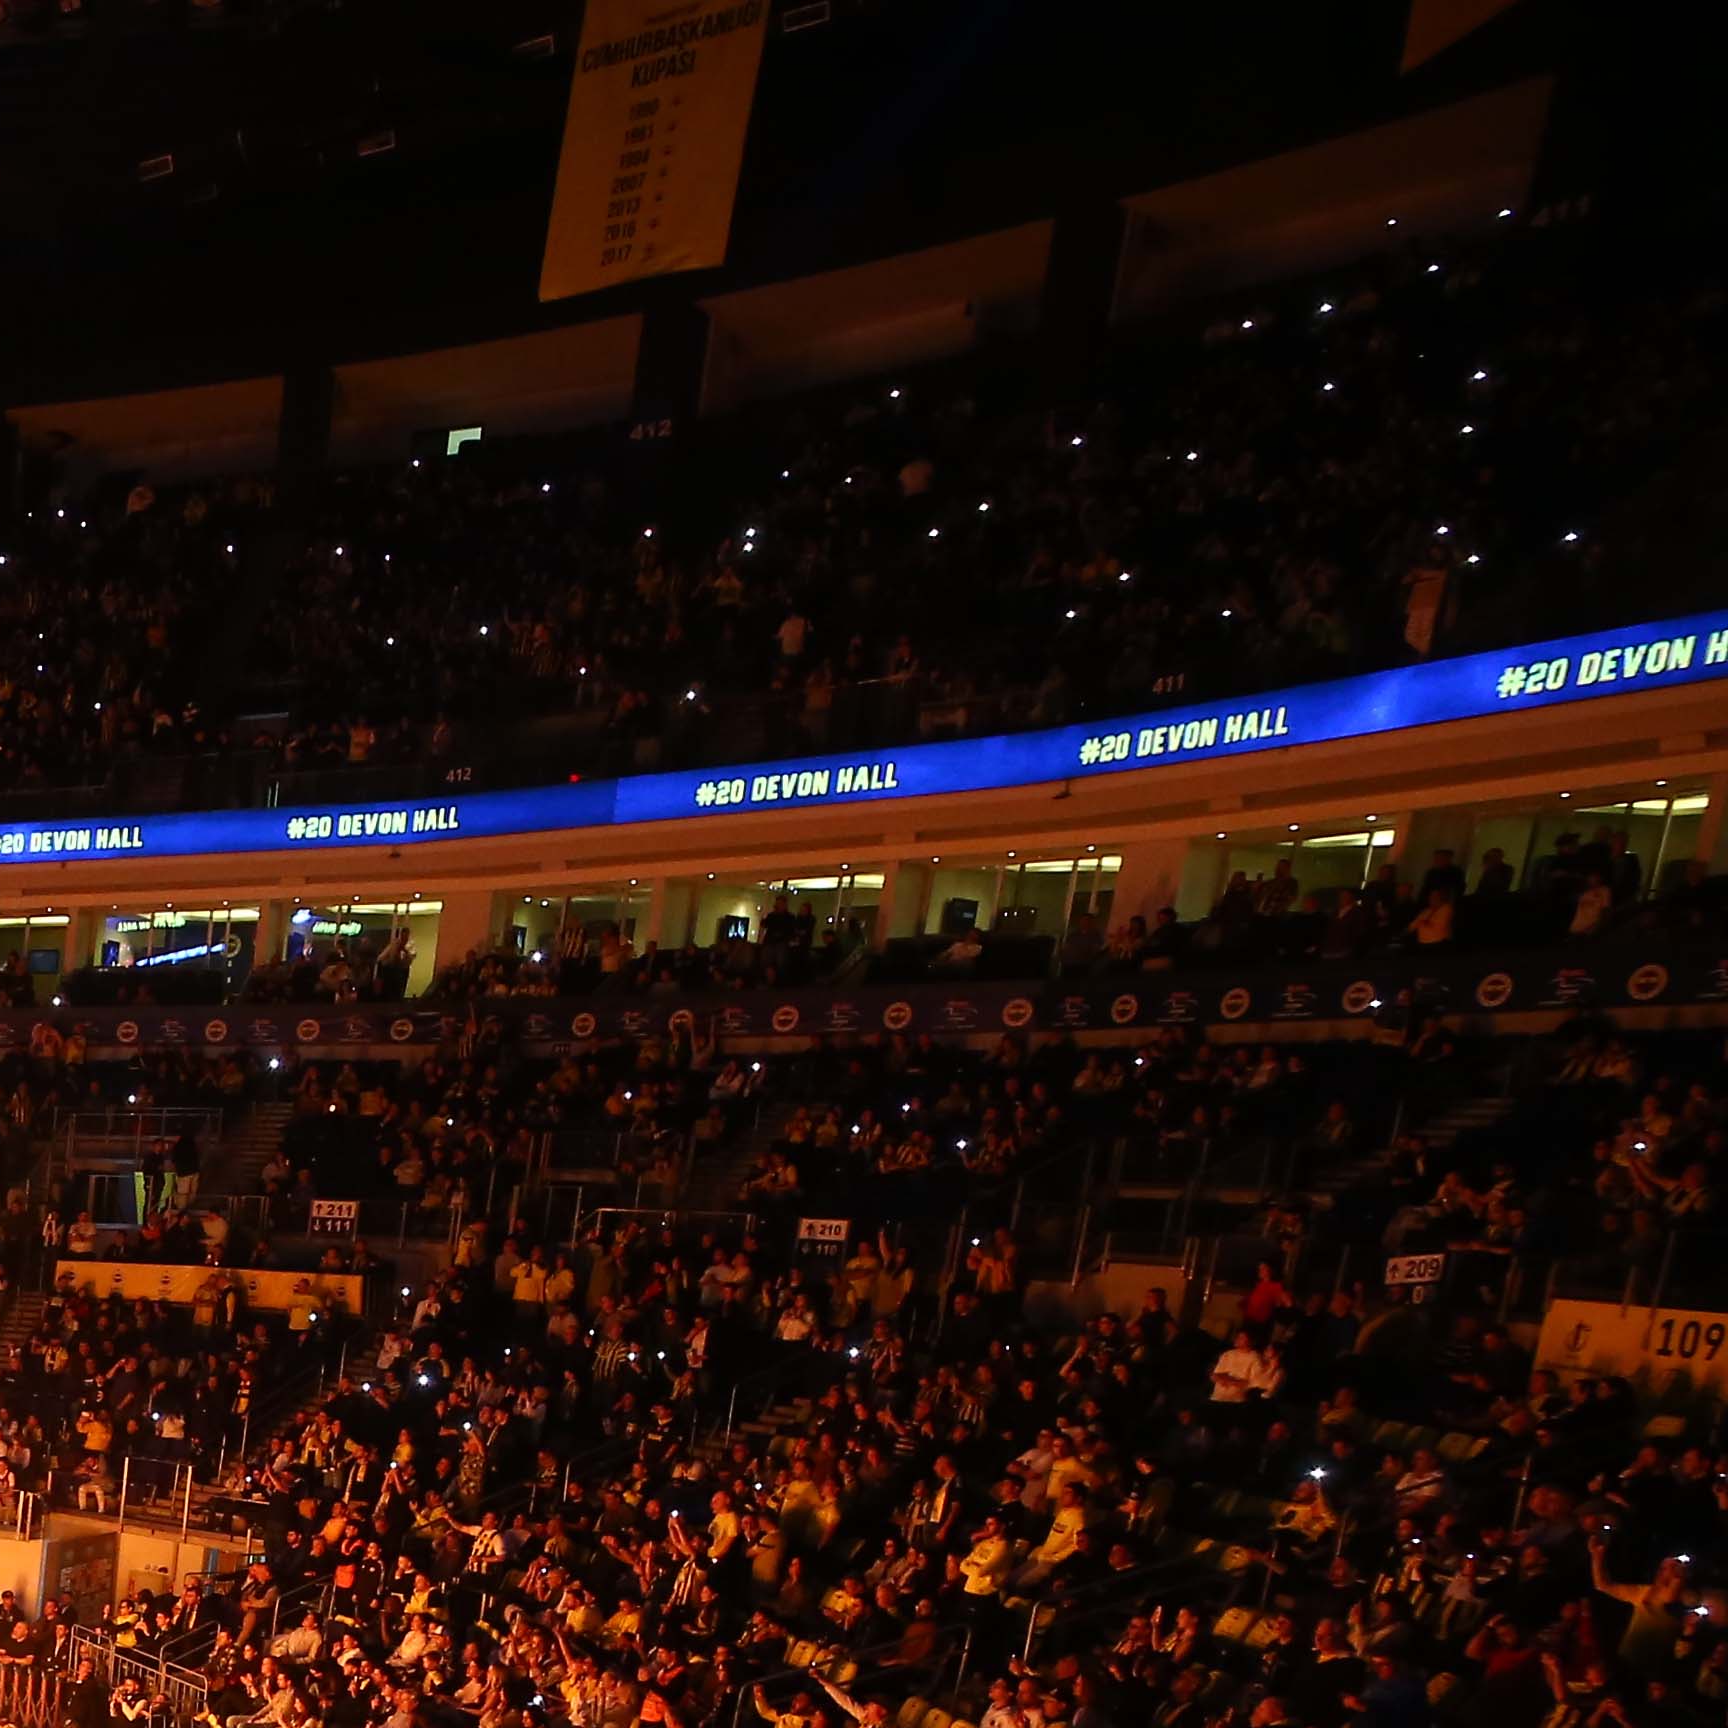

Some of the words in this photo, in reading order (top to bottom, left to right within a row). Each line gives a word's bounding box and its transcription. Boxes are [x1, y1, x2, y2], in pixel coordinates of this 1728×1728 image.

[1497, 658, 1568, 698] #20
[1576, 635, 1695, 686] DEVON
[1079, 733, 1131, 765] #20
[1136, 719, 1218, 757] DEVON
[1223, 707, 1288, 744] HALL
[446, 767, 473, 782] 412
[695, 779, 745, 806] #20
[751, 770, 830, 802] DEVON
[836, 763, 897, 793] HALL
[287, 816, 332, 839] #20
[337, 811, 407, 837] DEVON
[412, 806, 458, 832] HALL
[29, 829, 91, 853] DEVON
[95, 826, 143, 849] HALL
[327, 1204, 353, 1217] 211
[326, 1219, 352, 1232] 111
[818, 1224, 841, 1237] 210
[1404, 1258, 1441, 1279] 209
[1656, 1318, 1726, 1362] 109
